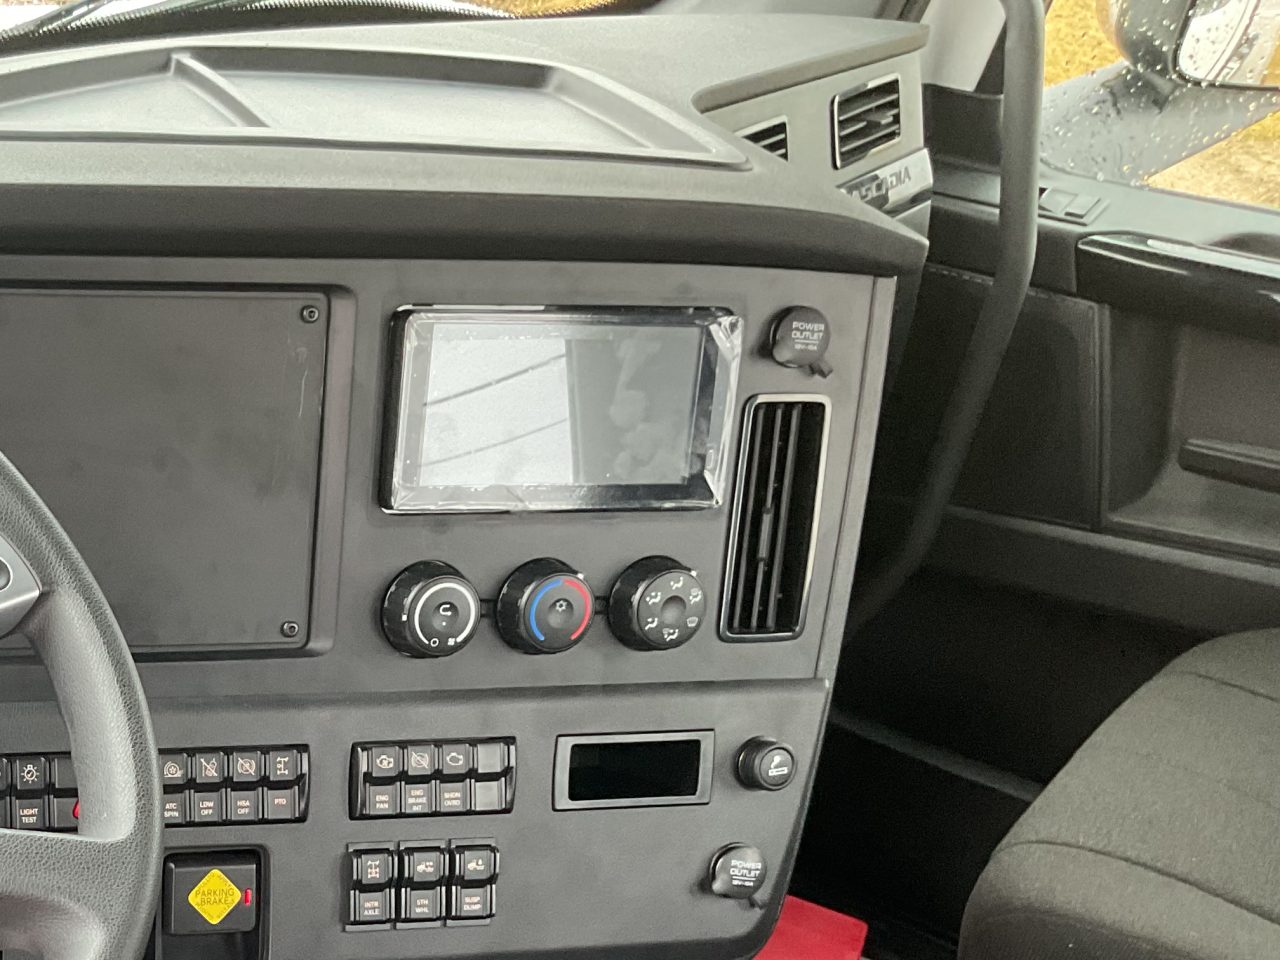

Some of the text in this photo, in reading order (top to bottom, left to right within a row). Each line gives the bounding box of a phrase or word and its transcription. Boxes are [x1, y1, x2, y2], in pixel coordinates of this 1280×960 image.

[792, 321, 824, 331] POWER
[792, 330, 823, 340] OUTLET
[731, 860, 761, 869] POWER
[730, 868, 760, 877] OUTLET
[195, 888, 234, 898] PARKING
[200, 896, 229, 905] BRAKE
